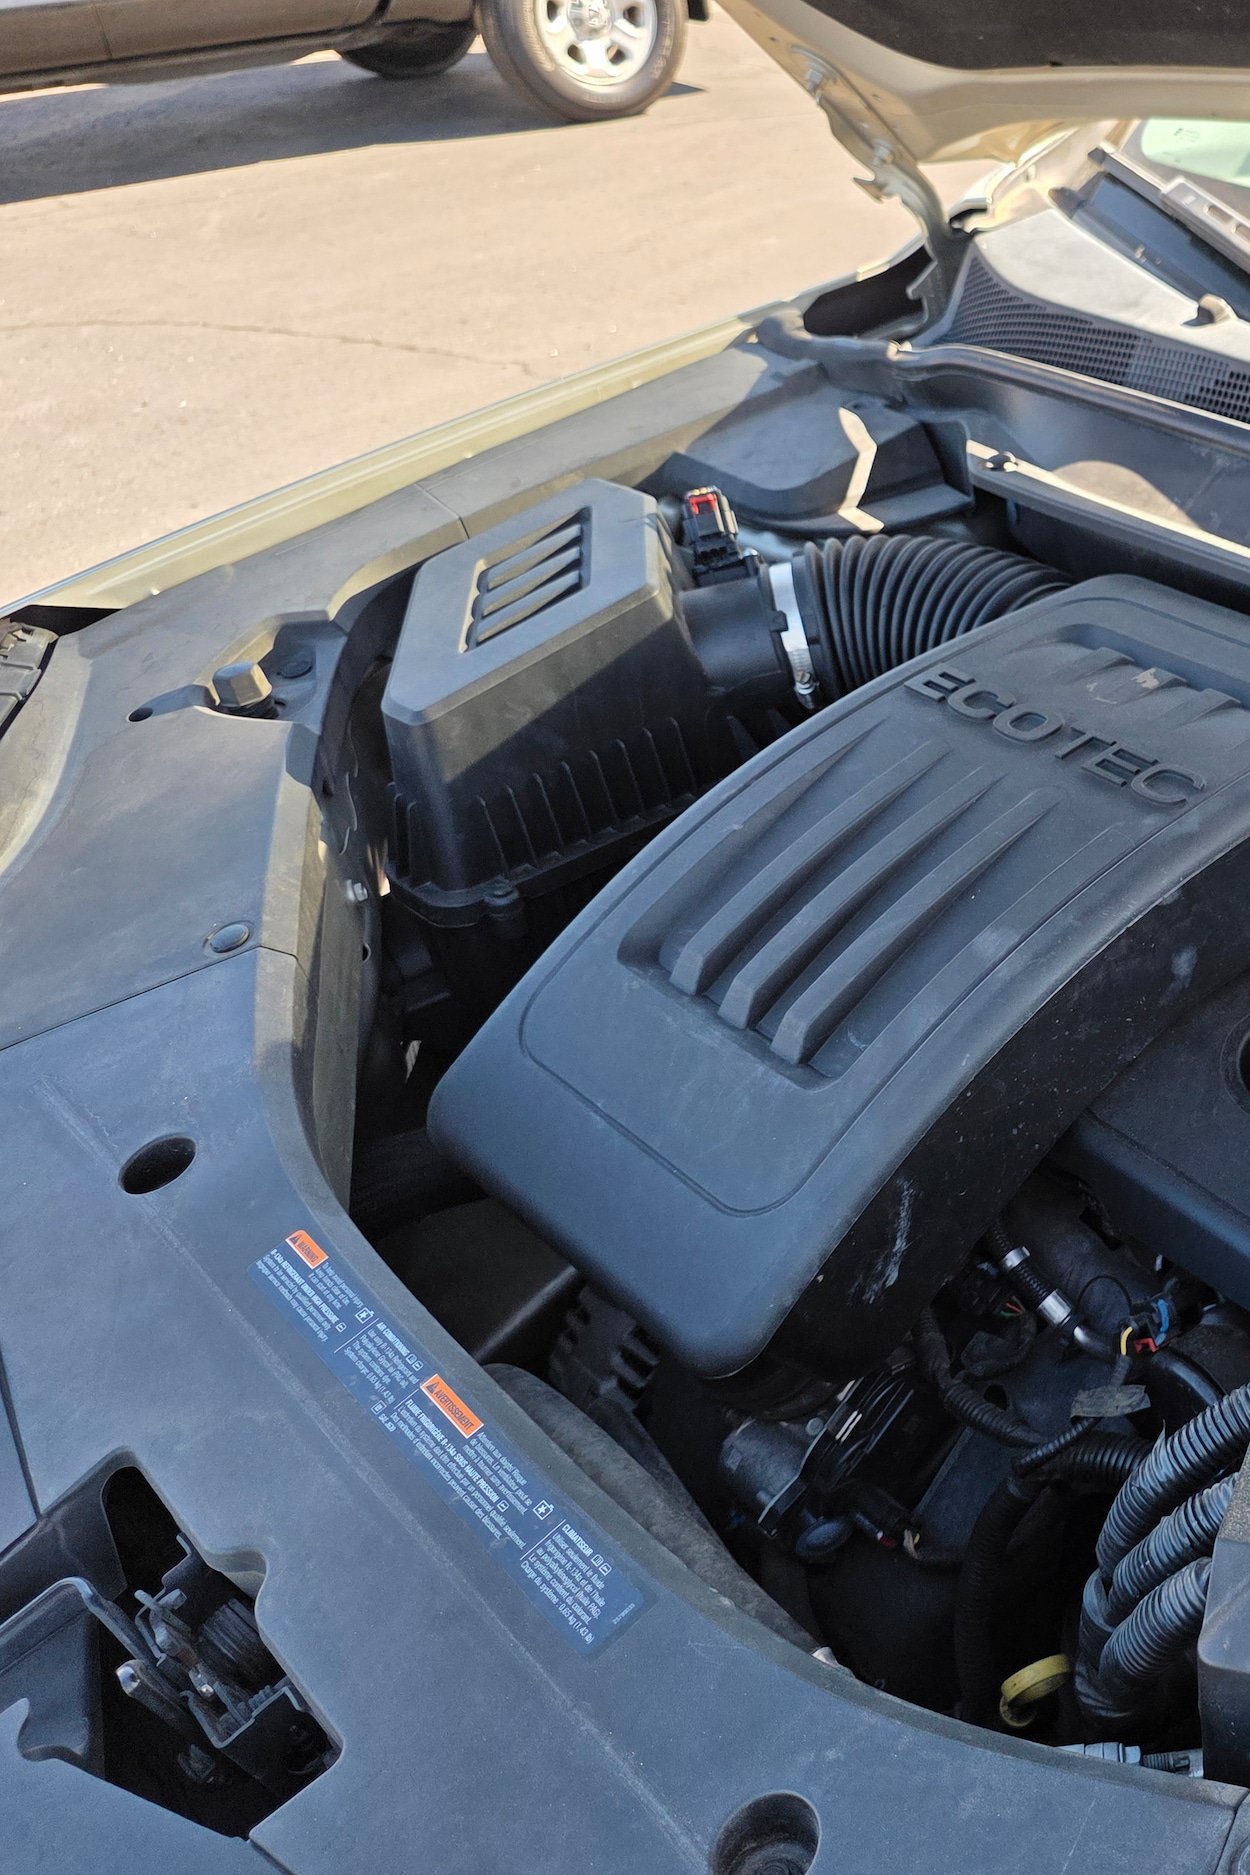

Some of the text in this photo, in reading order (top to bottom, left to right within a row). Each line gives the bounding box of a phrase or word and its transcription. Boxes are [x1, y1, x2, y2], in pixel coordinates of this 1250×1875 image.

[904, 663, 1206, 805] ECOTEC
[279, 1259, 306, 1286] REFRIGERANT
[299, 1281, 316, 1298] UNDER
[310, 1293, 323, 1306] HIGH
[317, 1302, 340, 1324] PRESSURE
[375, 1320, 411, 1357] AIR CONDITIONING
[432, 1388, 475, 1431] AVERTISSEMENT
[404, 1398, 423, 1416] FLUIDE
[439, 1437, 459, 1457] R-134a
[452, 1452, 469, 1468] SOUS
[462, 1463, 482, 1482] HAUTE
[474, 1477, 501, 1503] PRESSION
[491, 1448, 503, 1459] aux
[491, 1461, 502, 1471] Le
[560, 1523, 595, 1557] CLIMATISEUR
[527, 1552, 539, 1563] Le
[535, 1546, 545, 1556] au
[517, 1559, 540, 1580] Charge
[531, 1558, 555, 1581] système
[562, 1560, 585, 1582] R-134a
[563, 1546, 591, 1573] seulement
[584, 1568, 595, 1578] le
[532, 1575, 545, 1586] du
[578, 1577, 589, 1587] et
[582, 1582, 595, 1593] de
[536, 1581, 562, 1605] système
[564, 1594, 576, 1605] du
[564, 1613, 579, 1625] kg
